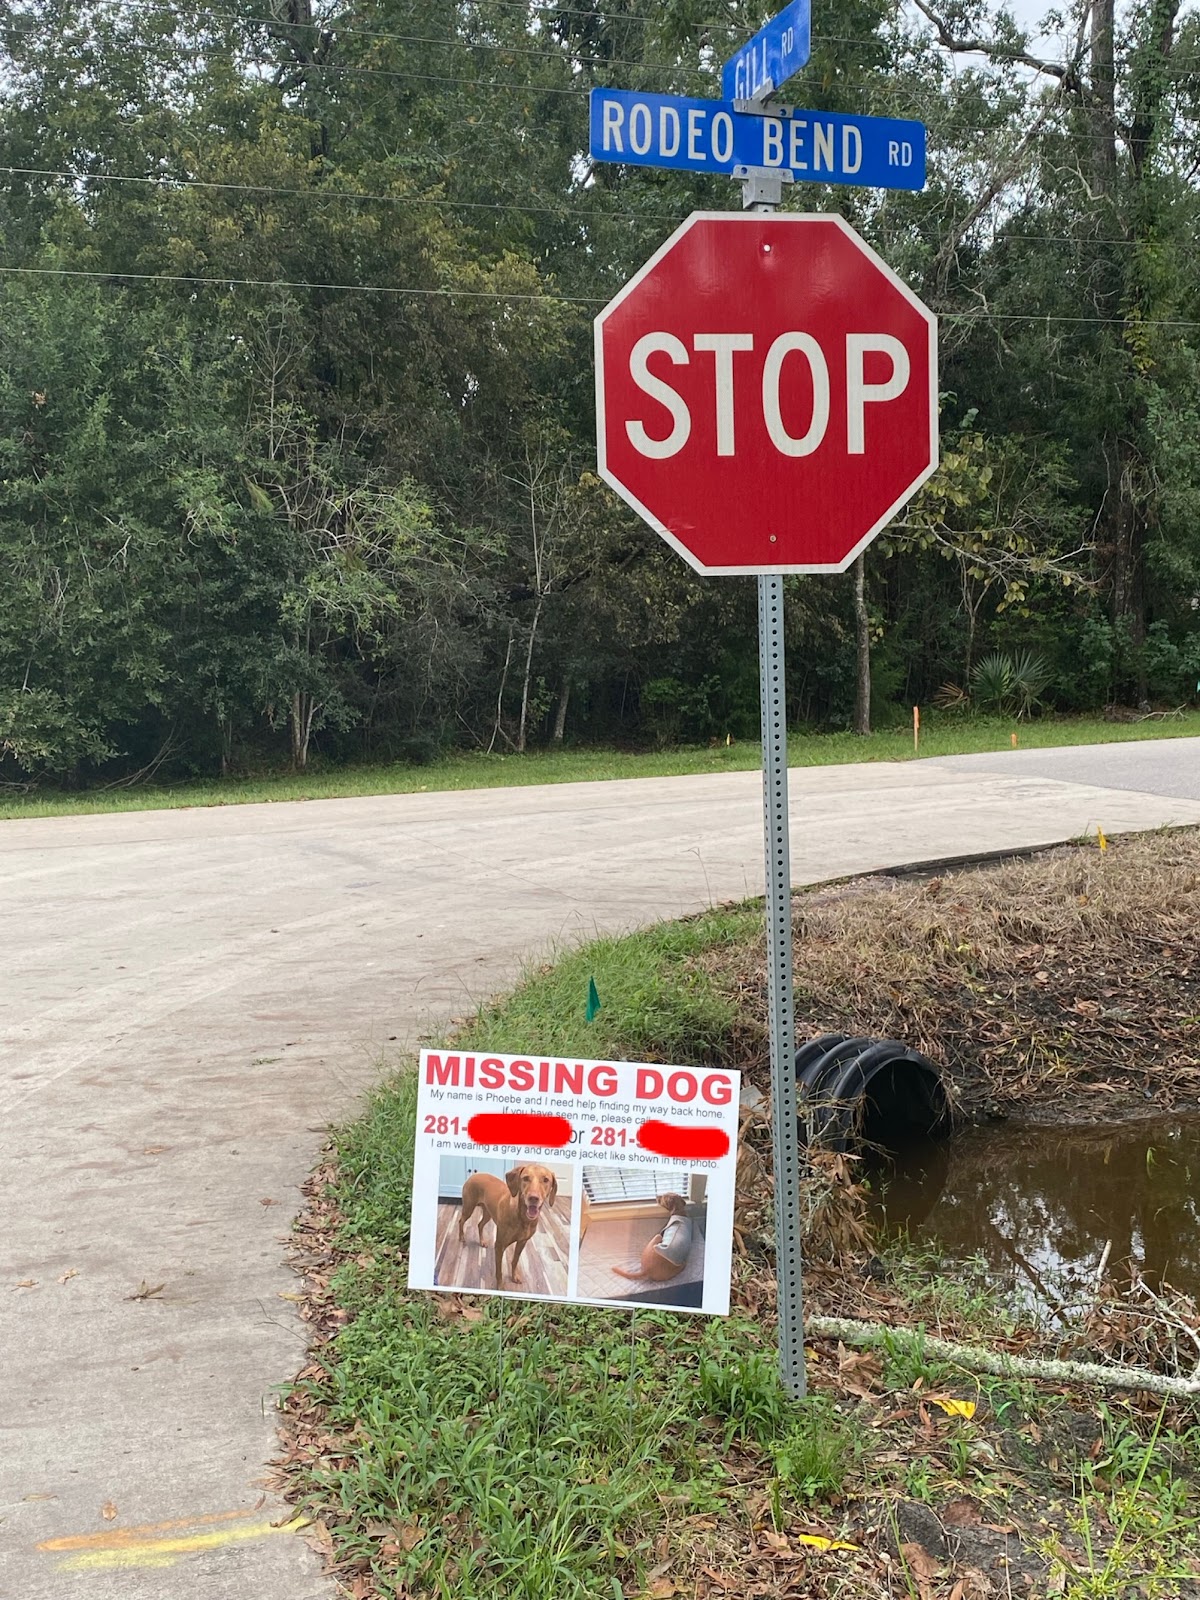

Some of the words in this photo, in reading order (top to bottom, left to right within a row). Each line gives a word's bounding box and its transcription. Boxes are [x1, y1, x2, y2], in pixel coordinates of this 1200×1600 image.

[735, 37, 771, 99] GILL
[781, 26, 794, 59] RD
[602, 99, 735, 164] RODEO
[763, 116, 864, 175] BEND
[888, 140, 914, 168] RD
[624, 331, 911, 460] STOP
[426, 1054, 618, 1097] MISSING
[635, 1068, 732, 1106] DOG
[430, 1089, 444, 1101] My
[446, 1090, 473, 1100] name
[475, 1091, 483, 1101] is
[486, 1092, 522, 1104] Phoebe
[524, 1096, 542, 1106] and
[550, 1097, 574, 1108] need
[576, 1098, 597, 1111] help
[599, 1100, 630, 1113] finding
[632, 1104, 647, 1115] my
[649, 1105, 669, 1117] way
[671, 1105, 694, 1117] back
[696, 1107, 725, 1119] home.
[502, 1105, 509, 1115] If
[530, 1108, 553, 1117] have
[555, 1110, 578, 1121] seen
[580, 1113, 599, 1123] me,
[601, 1112, 632, 1124] please
[436, 1140, 451, 1148] am
[453, 1140, 490, 1153] wearing
[501, 1145, 521, 1155] gray
[524, 1146, 542, 1156] and
[544, 1147, 577, 1160] orange
[579, 1149, 608, 1160] jacket
[609, 1150, 626, 1161] like
[628, 1152, 659, 1164] shown
[661, 1155, 670, 1164] in
[672, 1157, 688, 1166] the
[690, 1158, 719, 1169] photo.
[568, 1129, 586, 1145] or
